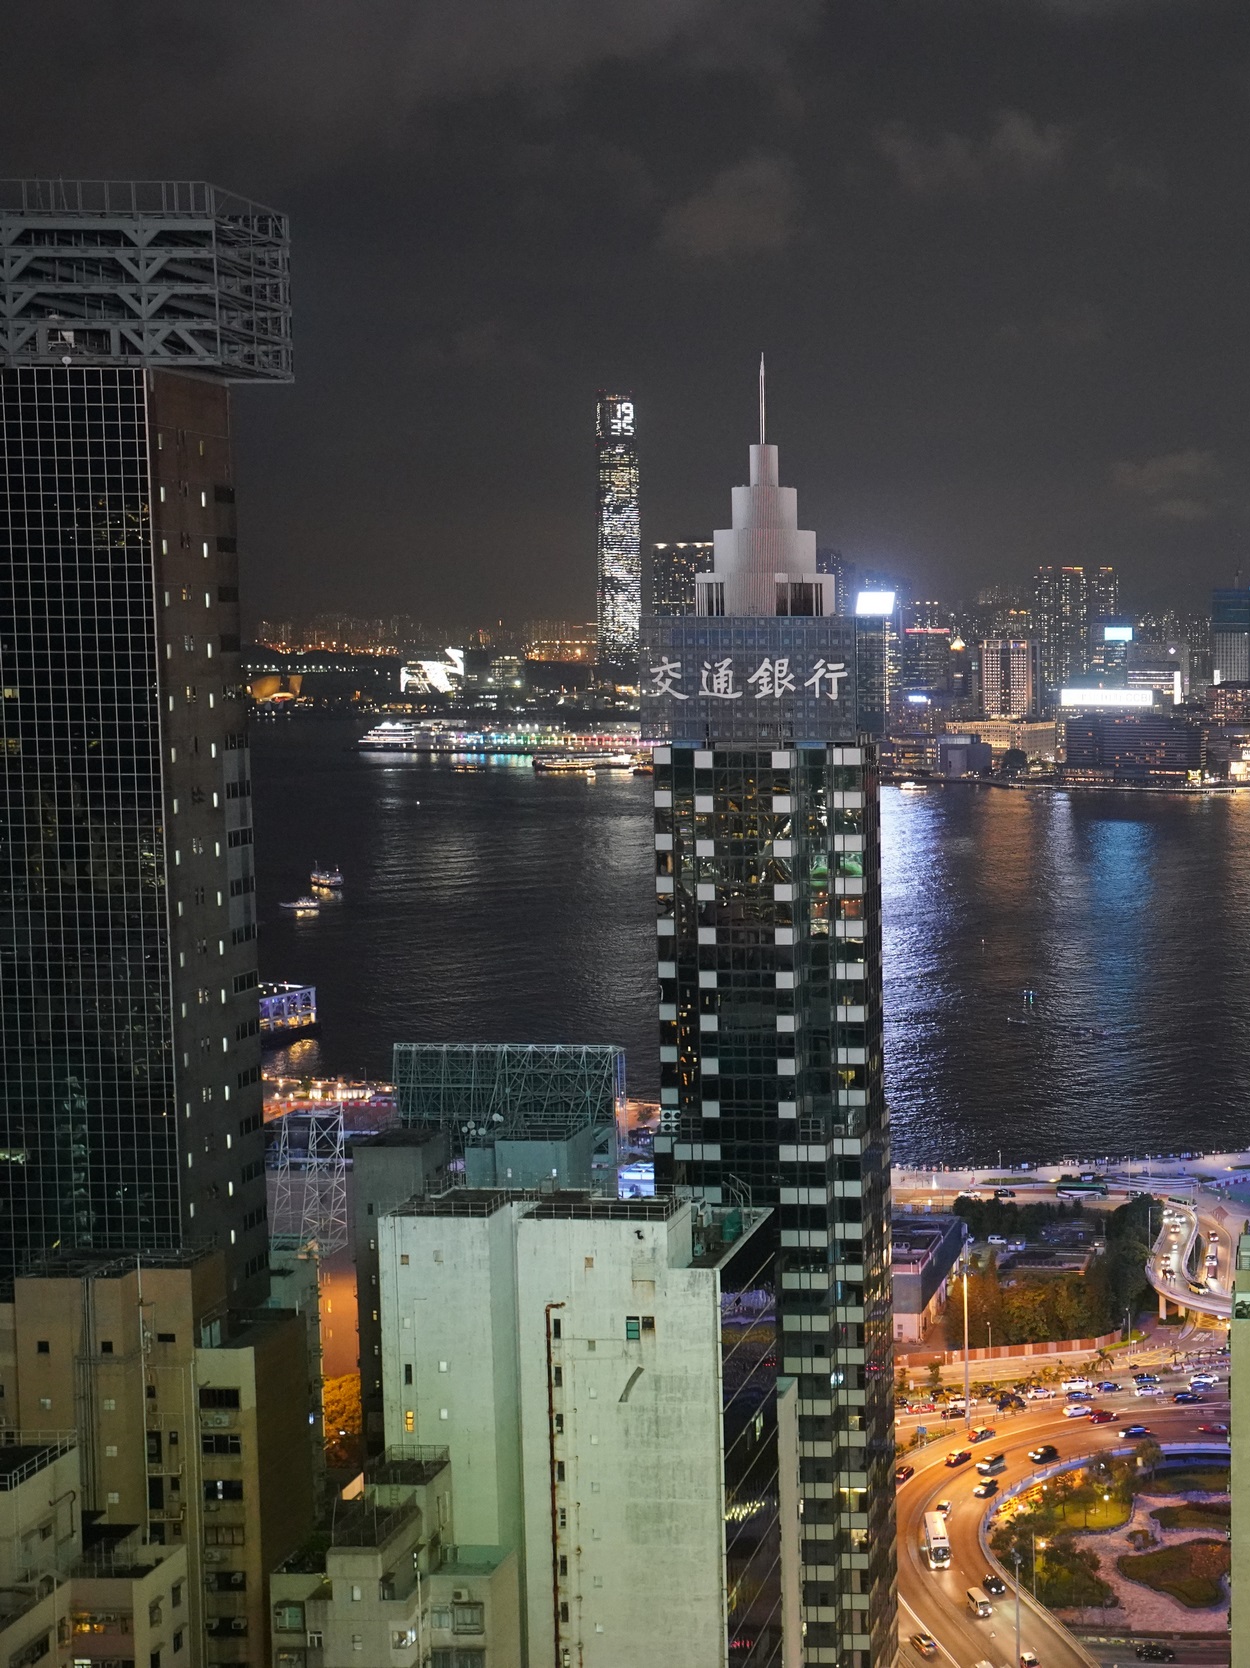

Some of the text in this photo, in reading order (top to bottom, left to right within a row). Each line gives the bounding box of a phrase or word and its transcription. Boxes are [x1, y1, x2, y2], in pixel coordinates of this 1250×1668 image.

[616, 402, 634, 419] 19
[648, 656, 849, 700] 交通銀行
